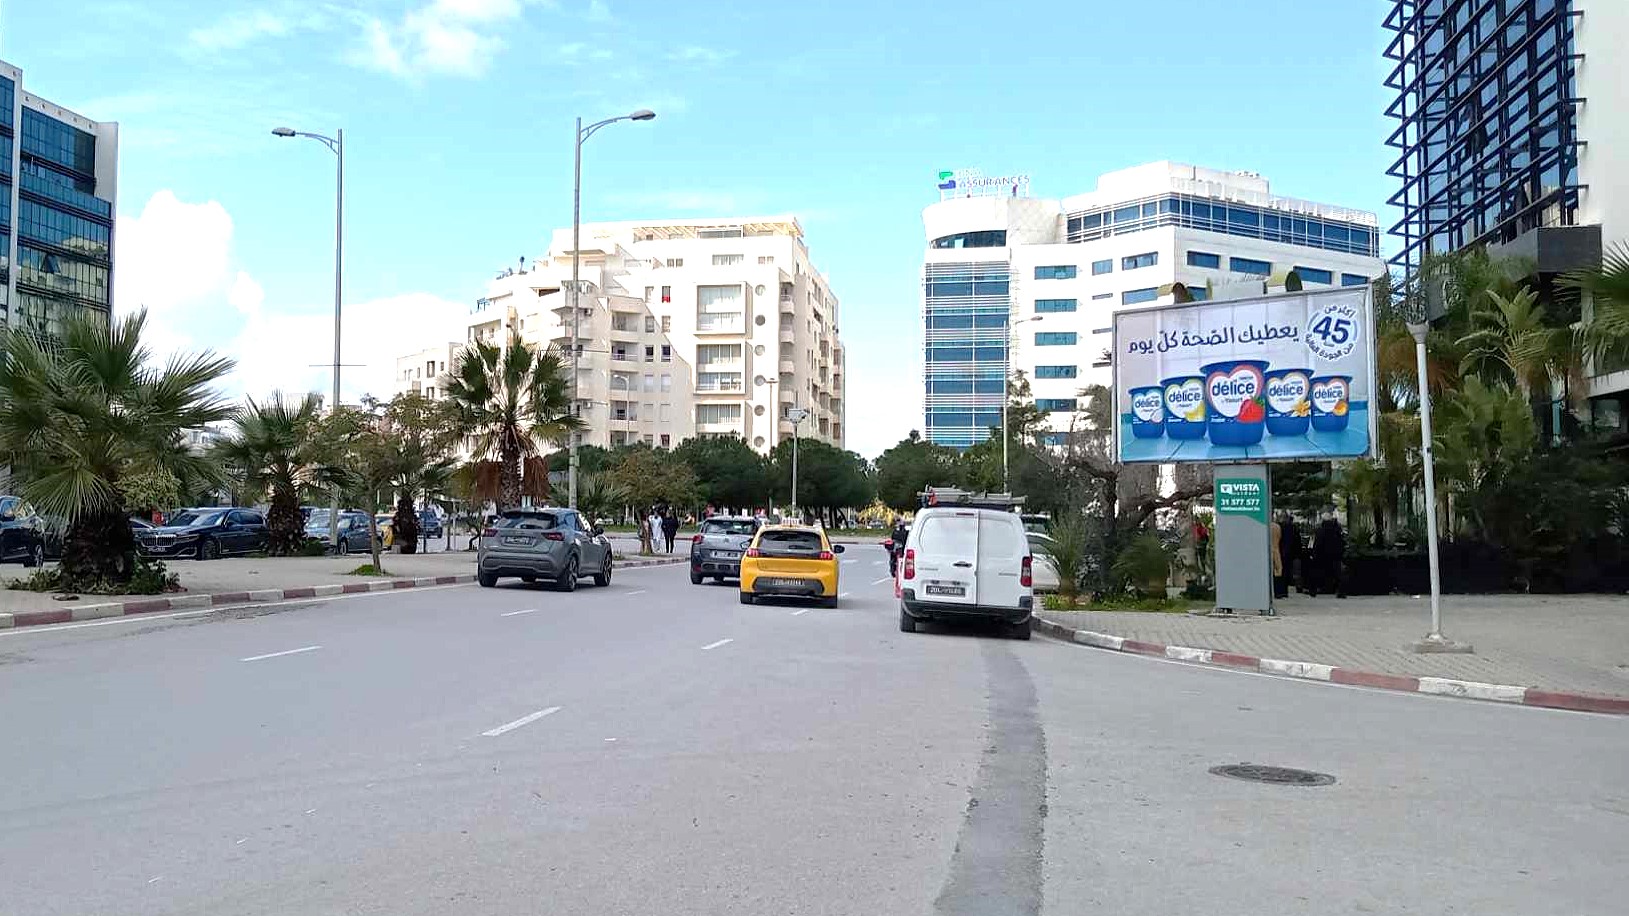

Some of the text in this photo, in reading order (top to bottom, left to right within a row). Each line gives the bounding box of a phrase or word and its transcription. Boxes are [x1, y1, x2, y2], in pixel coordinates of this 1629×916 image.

[1238, 325, 1299, 344] يعطيك
[1313, 316, 1351, 344] 45
[1128, 337, 1153, 354] يوم
[1212, 382, 1255, 396] délice
[1269, 385, 1303, 397] délice
[1314, 388, 1343, 400] délice
[1134, 398, 1160, 408] délice
[1168, 390, 1201, 403] délice
